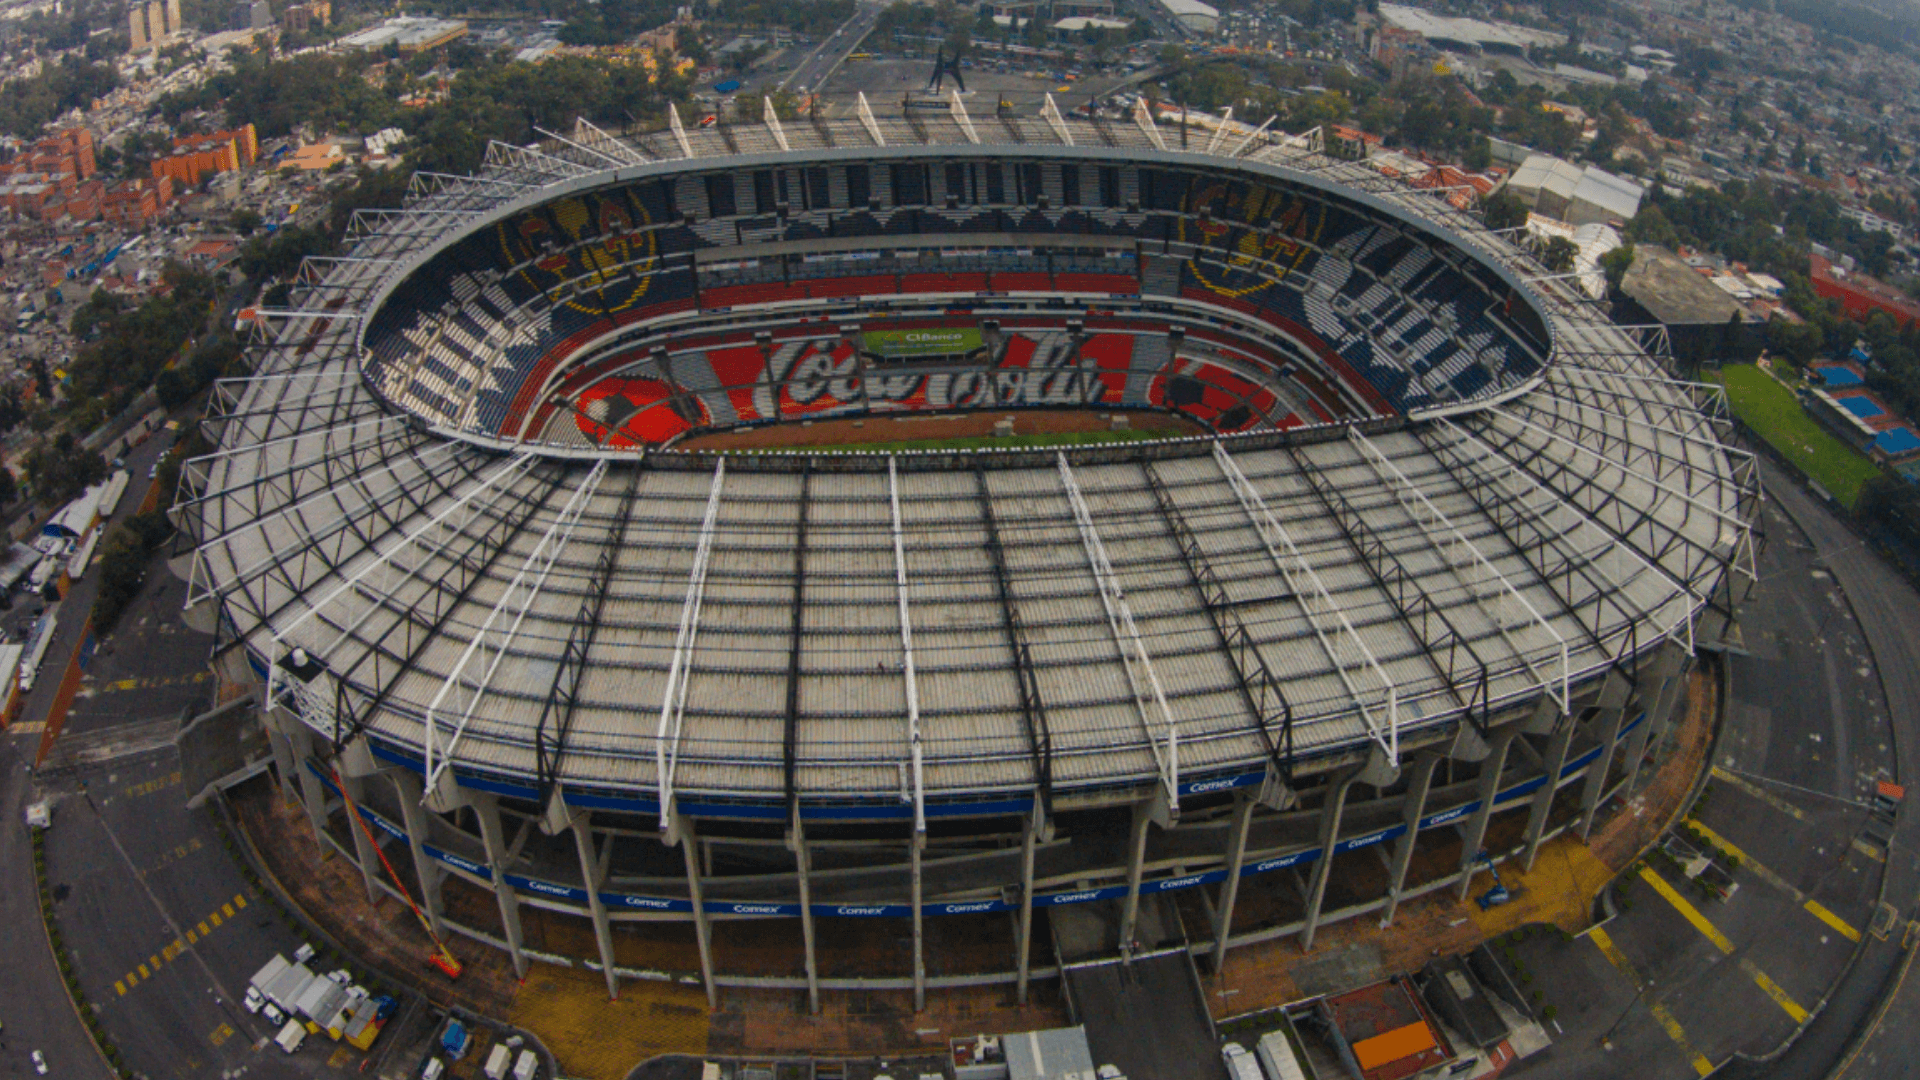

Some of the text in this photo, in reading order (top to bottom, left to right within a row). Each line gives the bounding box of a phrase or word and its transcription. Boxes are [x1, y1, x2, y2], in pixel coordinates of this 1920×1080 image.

[1189, 776, 1240, 792] Comex
[1257, 855, 1300, 870] Comex
[529, 881, 571, 895] Comex
[1160, 875, 1205, 889] Comex
[625, 897, 671, 907] Comex
[1053, 891, 1102, 903] Comex
[733, 904, 781, 914] Comex
[837, 906, 886, 915] Comex
[946, 902, 994, 913] Comex
